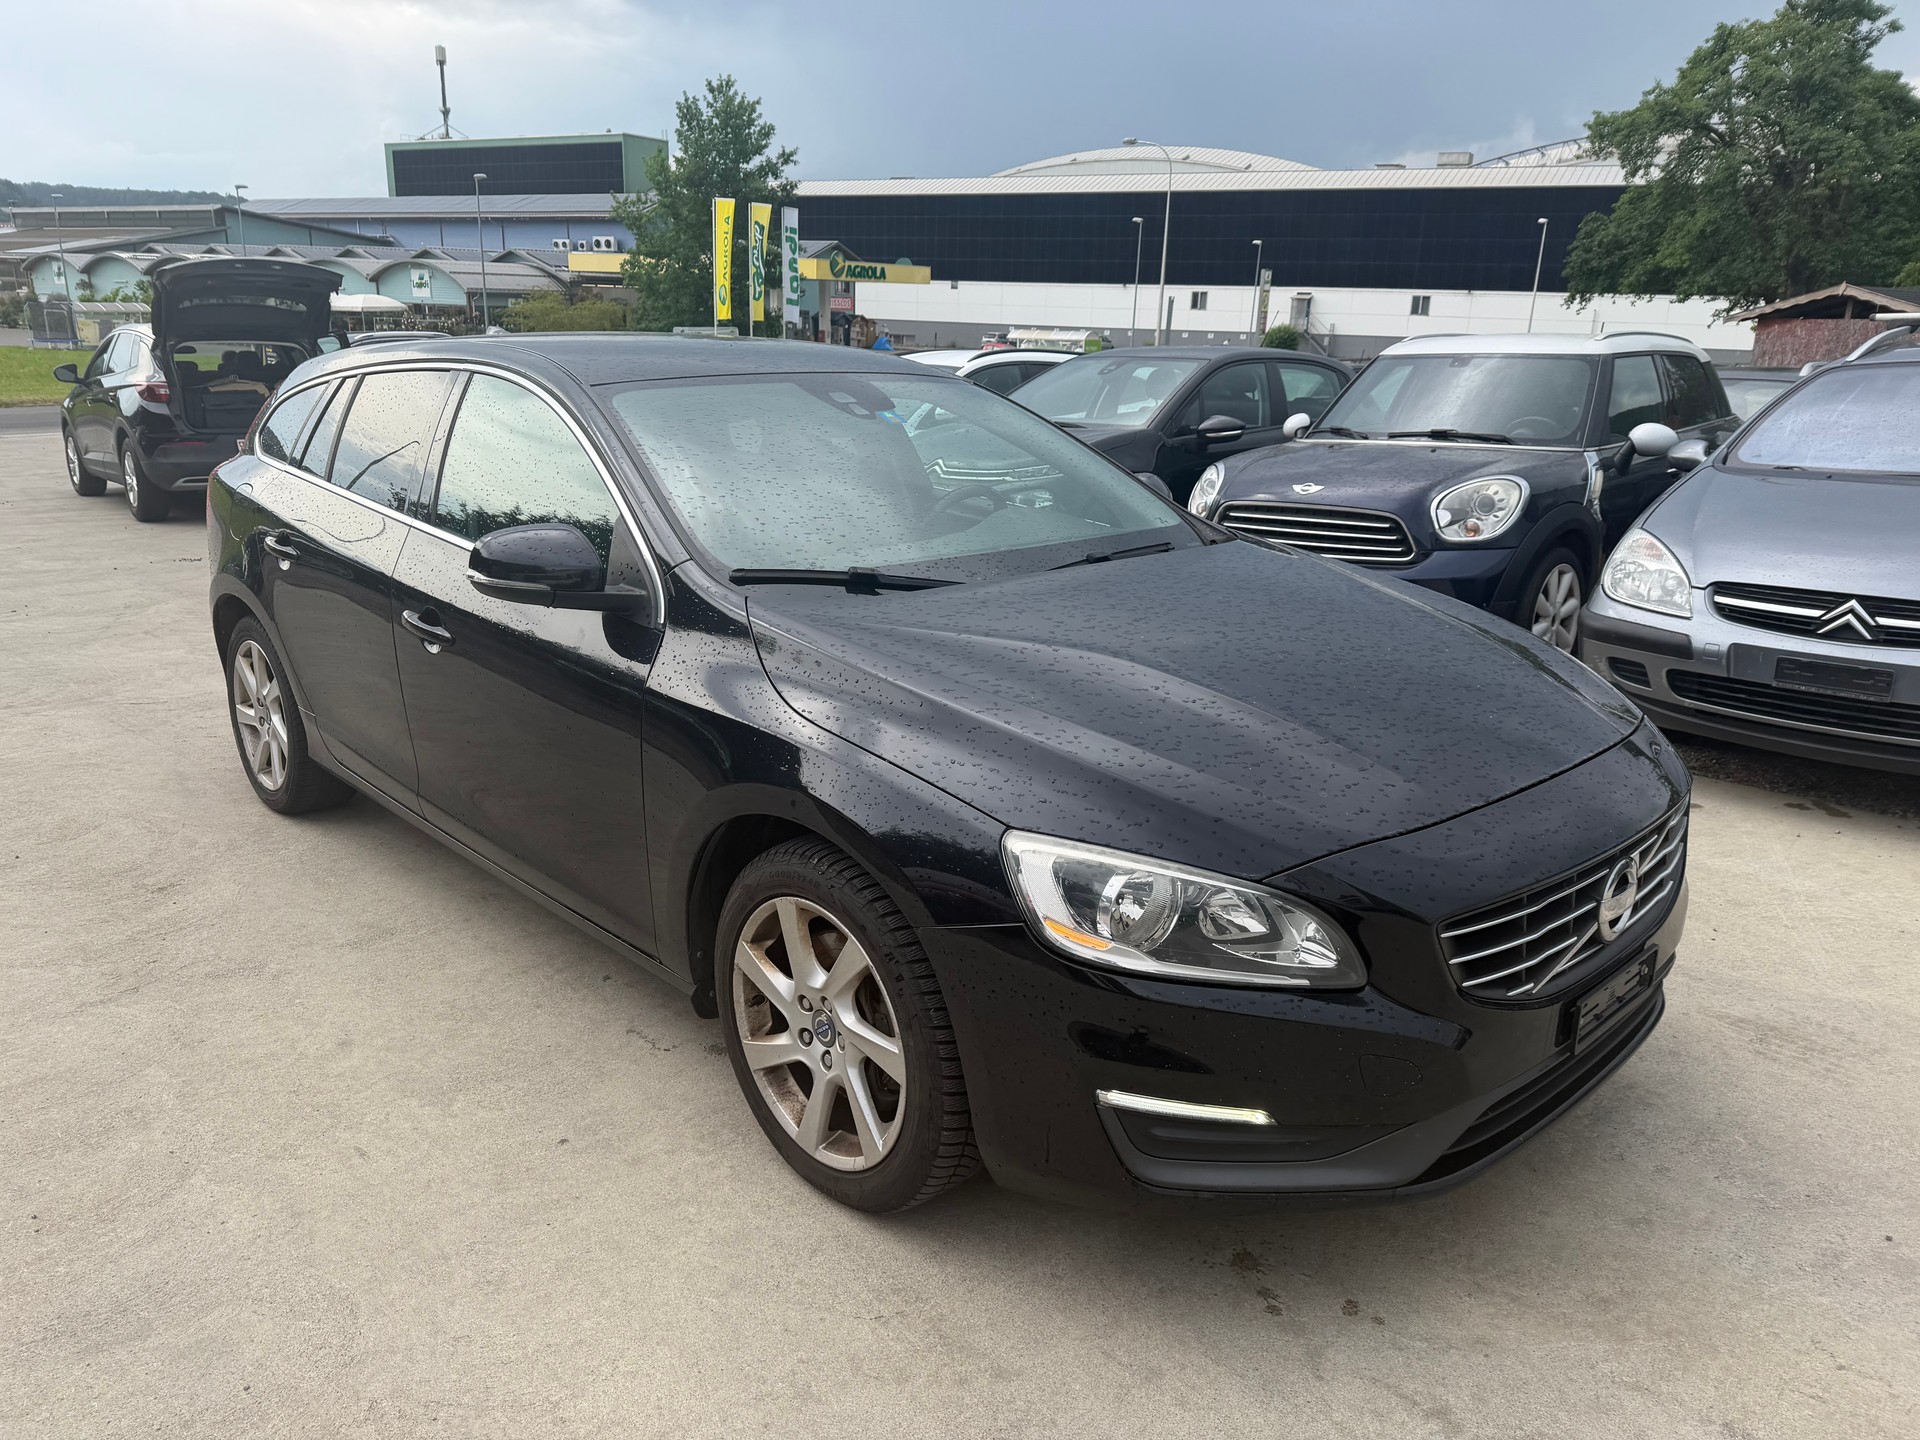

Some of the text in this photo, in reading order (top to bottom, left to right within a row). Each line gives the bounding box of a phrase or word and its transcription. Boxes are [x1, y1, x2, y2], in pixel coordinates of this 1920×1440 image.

[723, 215, 731, 282] AGROLA
[784, 225, 799, 306] Landi
[845, 264, 887, 280] AGROLA
[768, 870, 821, 889] GOODYEAR
